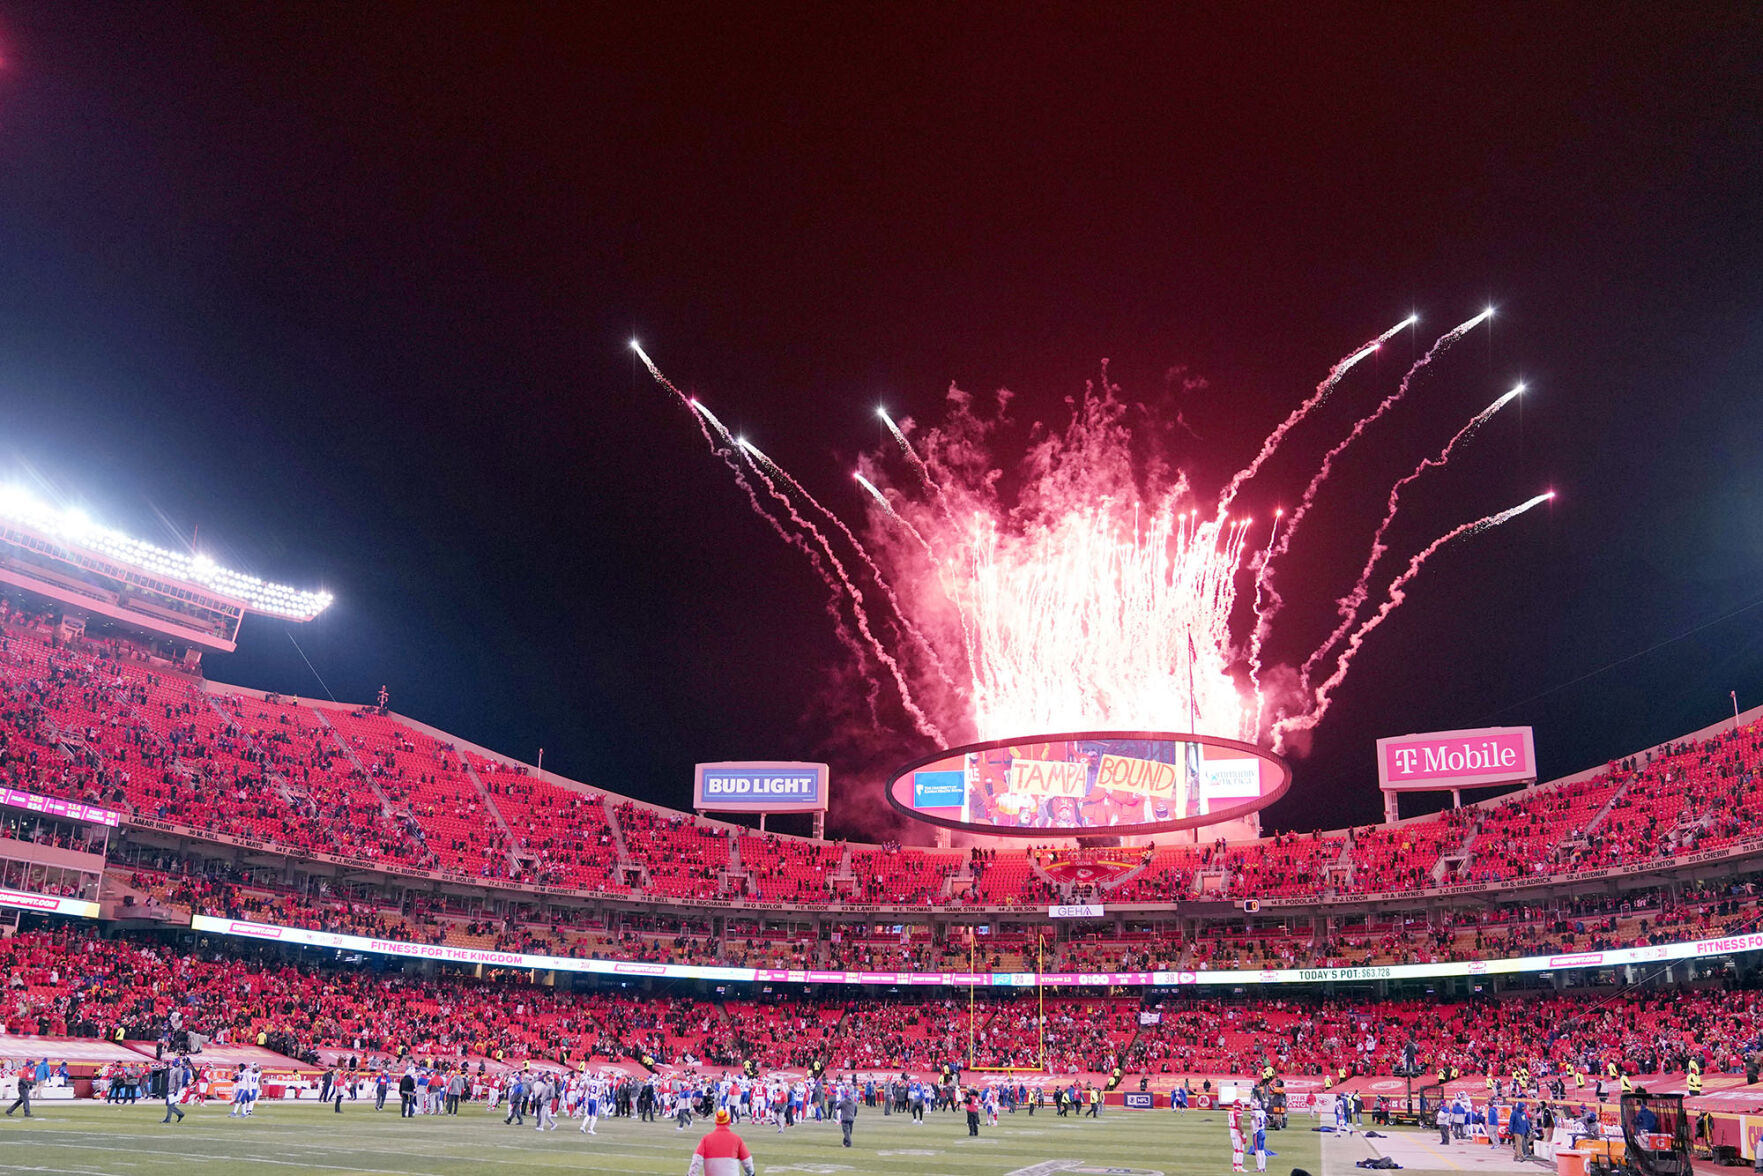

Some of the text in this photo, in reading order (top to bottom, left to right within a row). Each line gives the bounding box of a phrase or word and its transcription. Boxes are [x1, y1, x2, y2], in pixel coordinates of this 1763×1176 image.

[1422, 742, 1516, 772] Mobile
[1014, 762, 1086, 793] TAMPA
[1098, 757, 1176, 791] BOUND
[708, 778, 750, 793] BUD
[129, 817, 175, 832] LAMAR HUNT
[205, 832, 220, 841] HILL
[246, 840, 264, 850] MAYS
[1703, 849, 1730, 860] CHERRY
[344, 858, 376, 869] ROBINSON
[401, 868, 430, 878] BURFORD
[1581, 869, 1609, 879] RUDNAY
[456, 876, 477, 884] HOLUB
[1517, 877, 1552, 887] HEADRICK
[501, 882, 522, 890] TYRER
[1451, 884, 1487, 894] STENERUD
[547, 887, 577, 896] GARRETT
[601, 892, 628, 901] DAWSON
[1398, 890, 1425, 898] HAYNES
[696, 899, 731, 907] BUCHANAN
[1345, 895, 1368, 903] LYNCH
[1058, 906, 1092, 916] GEHA
[1696, 935, 1763, 954] FITNESS FO
[371, 940, 523, 965] FITNESS FOR THE KINGDOM
[1014, 975, 1024, 984] 24
[1078, 974, 1109, 985] 0:00
[1165, 973, 1174, 982] 38
[1299, 970, 1338, 980] TODAY'S
